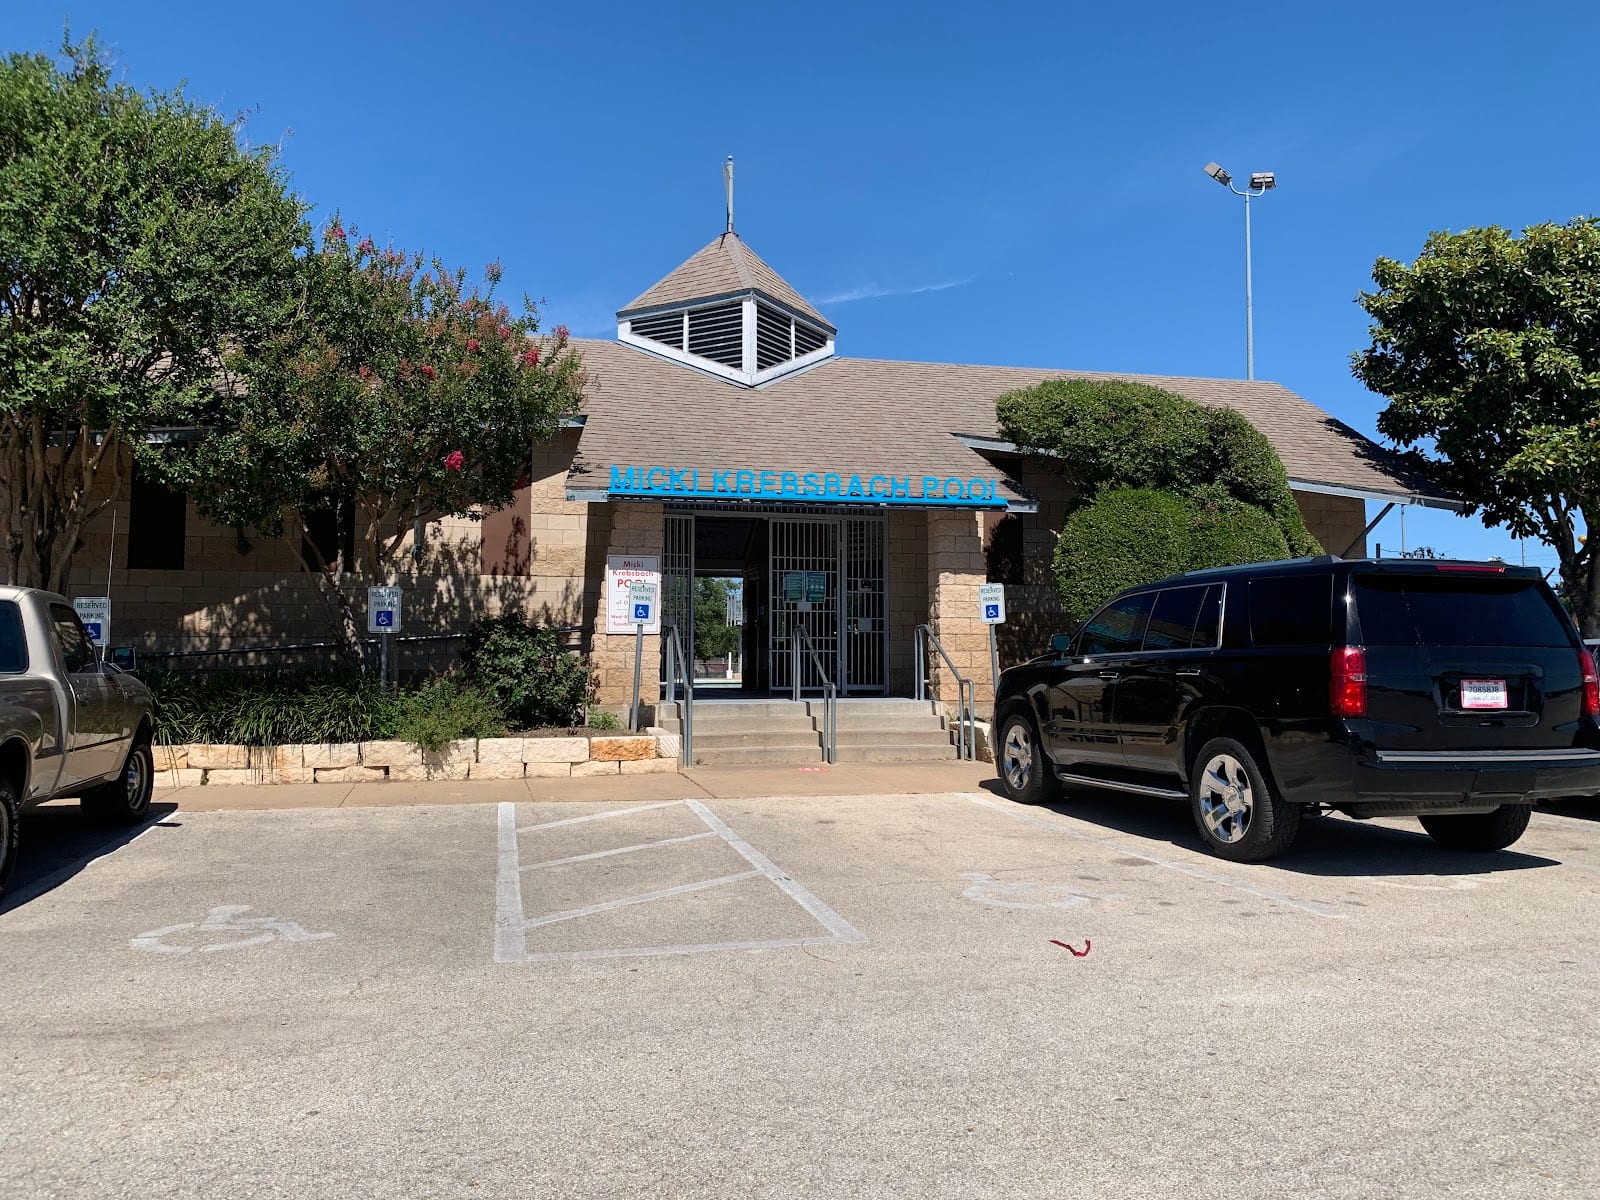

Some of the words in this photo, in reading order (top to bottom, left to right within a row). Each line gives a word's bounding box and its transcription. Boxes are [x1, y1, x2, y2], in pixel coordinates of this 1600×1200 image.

[609, 465, 699, 491] MICKI
[713, 469, 910, 498] KREBSBACH
[923, 476, 1005, 501] POOL
[623, 560, 644, 568] Micki
[612, 569, 654, 577] Krebsbach
[617, 579, 646, 588] PO
